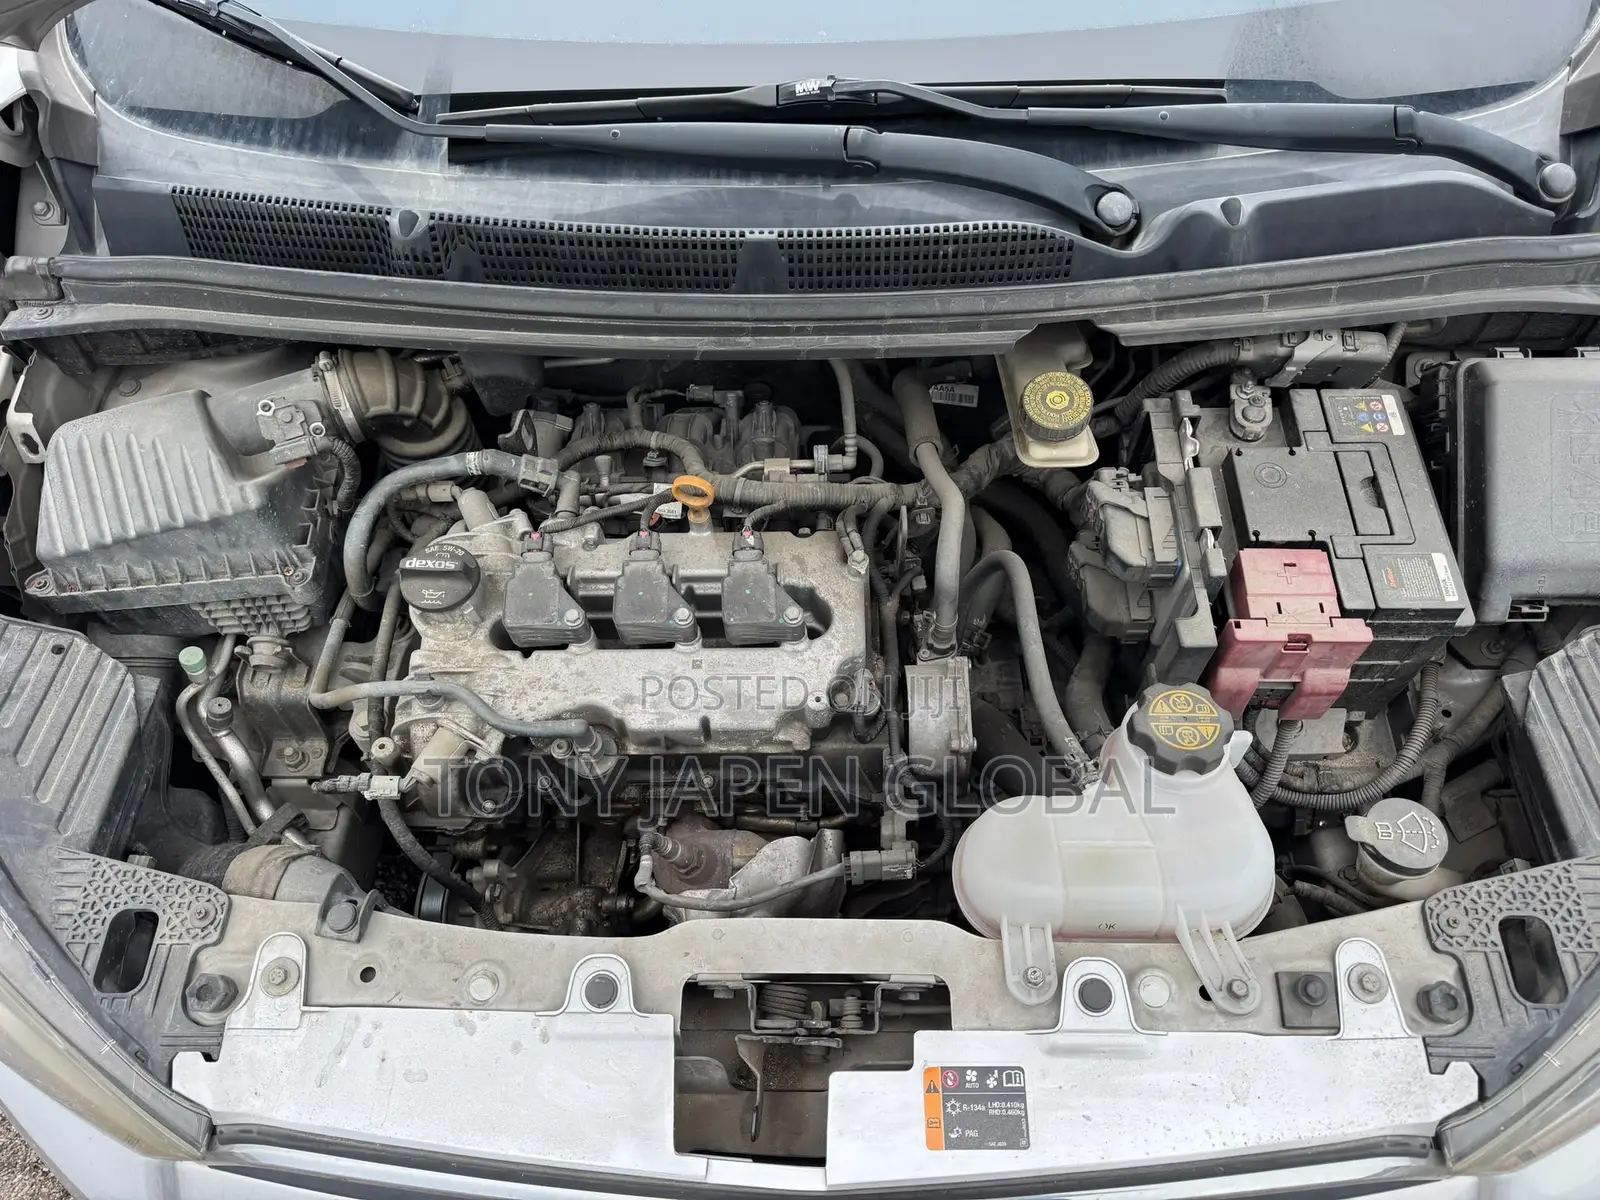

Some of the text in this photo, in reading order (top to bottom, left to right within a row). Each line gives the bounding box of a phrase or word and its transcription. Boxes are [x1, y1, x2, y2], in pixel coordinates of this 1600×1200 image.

[425, 545, 465, 556] SAE 5W-20
[405, 558, 459, 570] dexos
[1097, 922, 1117, 930] OK
[965, 1129, 979, 1137] PAG
